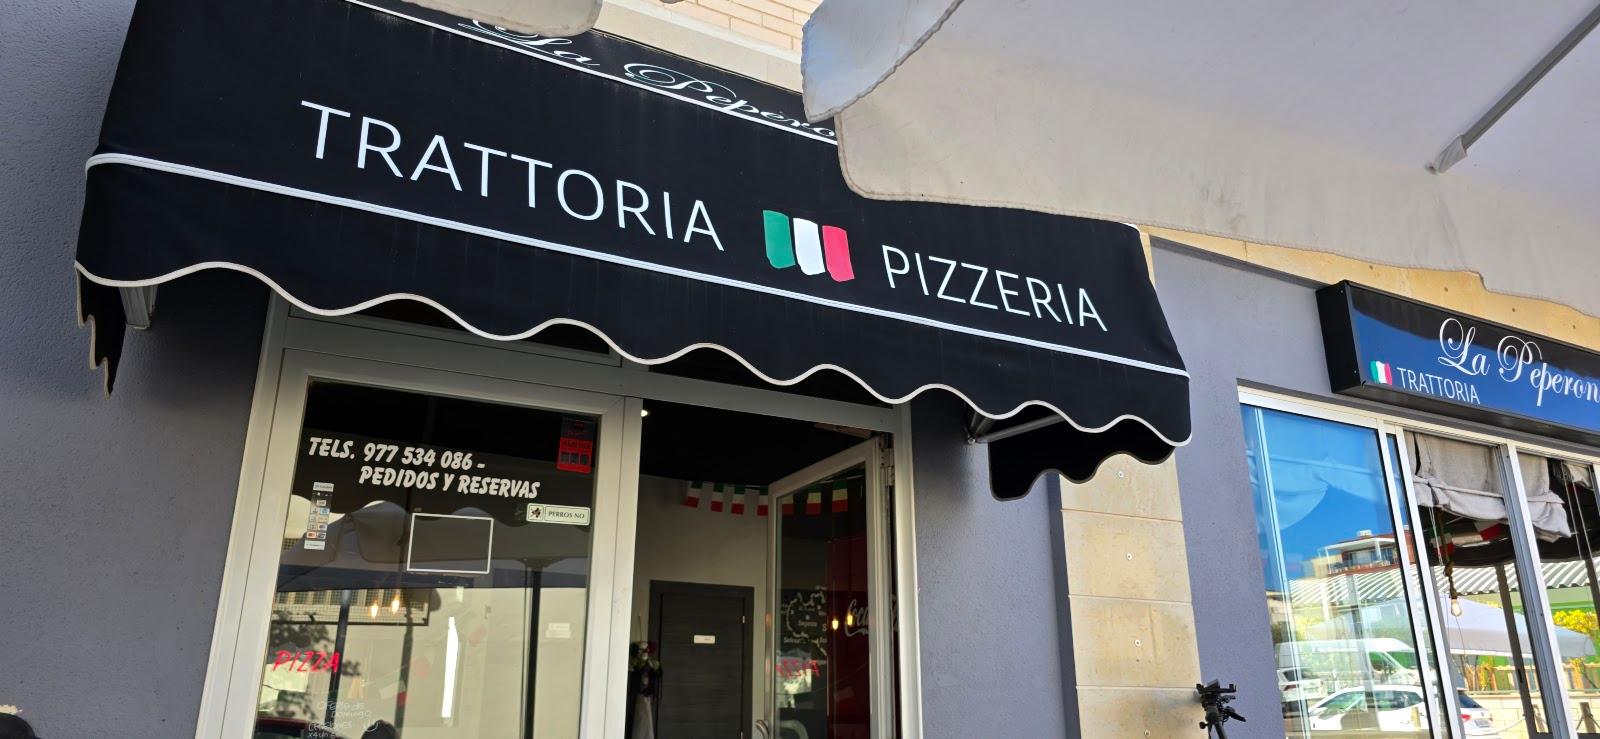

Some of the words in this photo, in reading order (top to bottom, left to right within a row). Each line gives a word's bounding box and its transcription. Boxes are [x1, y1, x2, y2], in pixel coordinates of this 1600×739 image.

[458, 19, 600, 67] La
[300, 99, 724, 252] TRATTORIA
[881, 244, 1108, 331] PIZZERIA
[1437, 317, 1490, 376] La
[1397, 367, 1480, 405] TRATTORIA
[308, 437, 355, 460] TELS.
[363, 442, 399, 463] 977
[402, 446, 435, 467] 534
[440, 450, 473, 471] 086
[358, 465, 440, 490] PEDIDOS
[442, 473, 454, 492] Y
[457, 475, 541, 499] RESERVAS
[548, 510, 573, 519] PERROS
[272, 649, 341, 673] PIZZA
